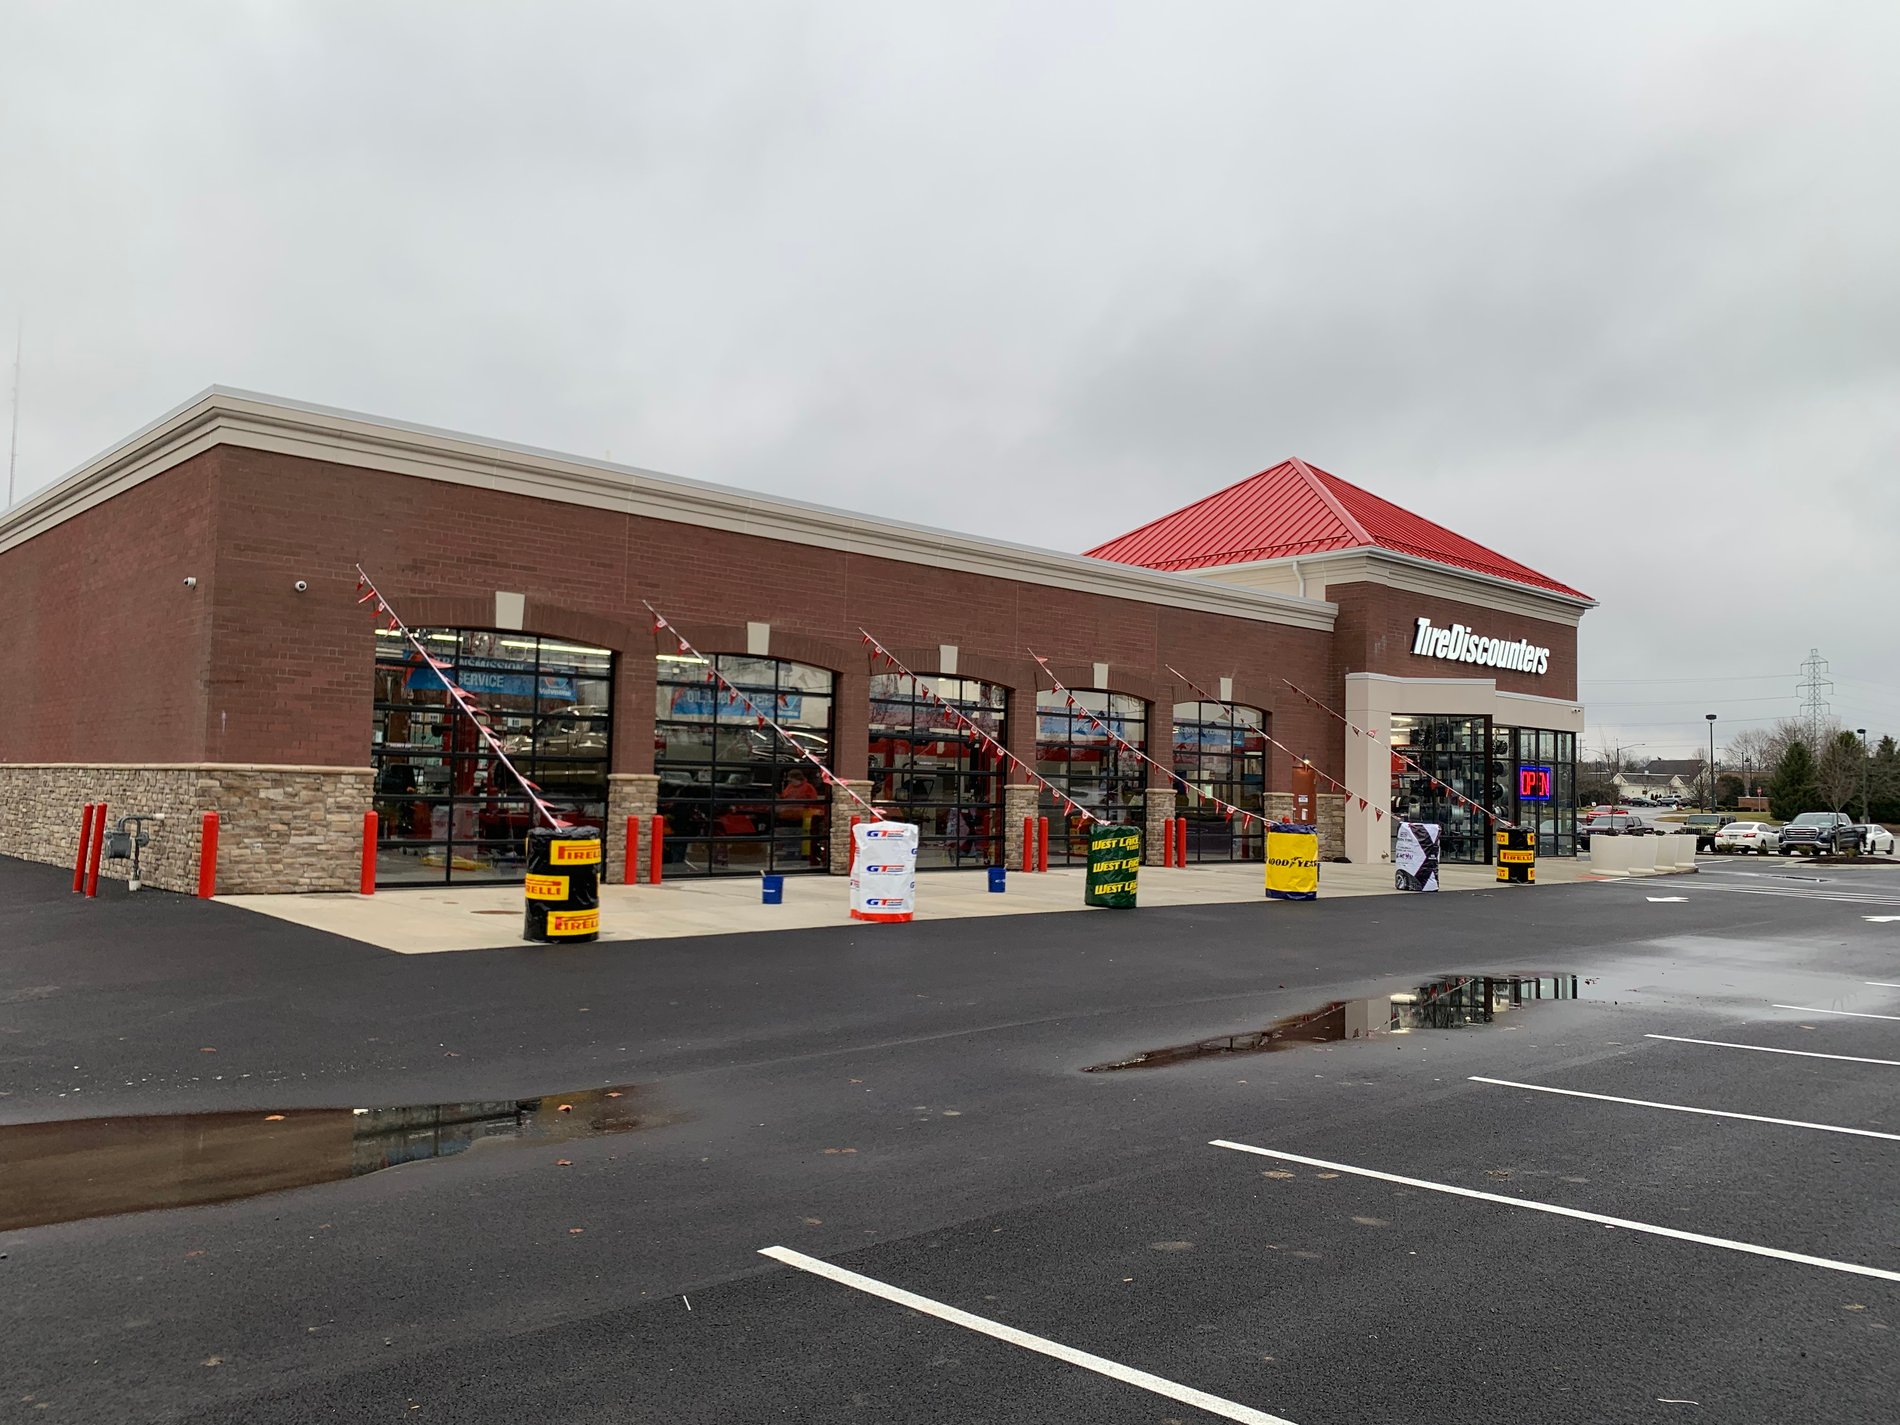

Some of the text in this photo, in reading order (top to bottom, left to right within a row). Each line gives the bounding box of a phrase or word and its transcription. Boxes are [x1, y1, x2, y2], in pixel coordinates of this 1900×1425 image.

[458, 671, 504, 688] SERVICE
[1522, 771, 1549, 796] OPEN
[1091, 838, 1118, 851] WEST
[1093, 860, 1121, 873] WEST
[526, 881, 561, 895] RELLI
[1095, 883, 1123, 895] WEST
